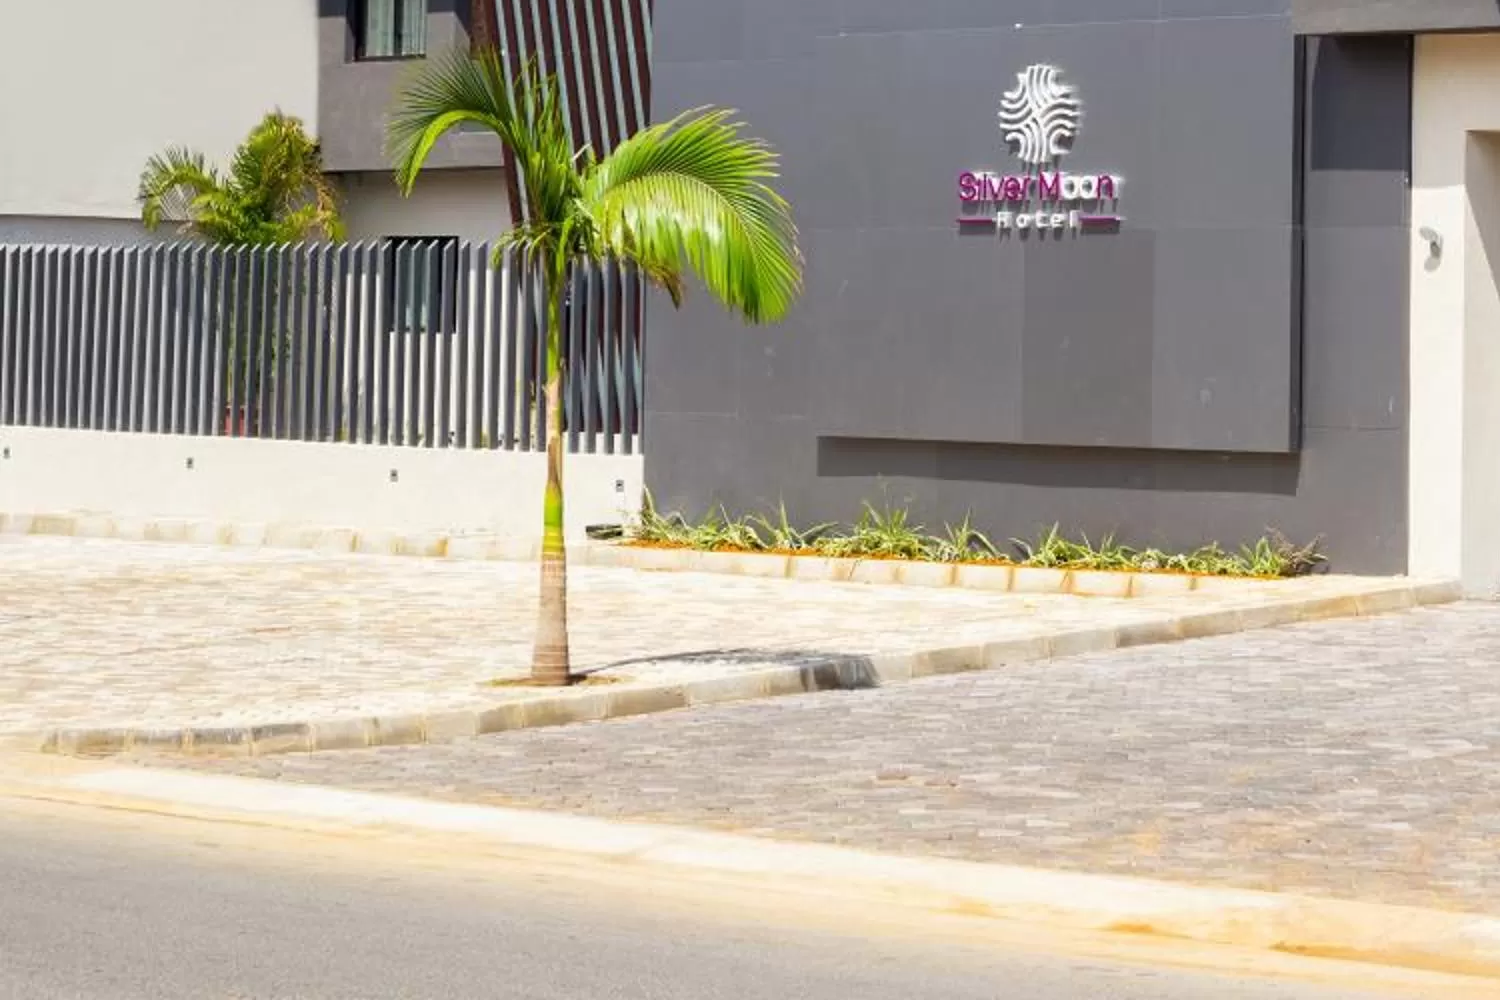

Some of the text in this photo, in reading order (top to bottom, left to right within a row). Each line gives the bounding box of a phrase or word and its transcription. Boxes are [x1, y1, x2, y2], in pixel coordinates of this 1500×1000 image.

[958, 170, 1115, 202] Silver Moon
[996, 210, 1078, 229] Hotel
